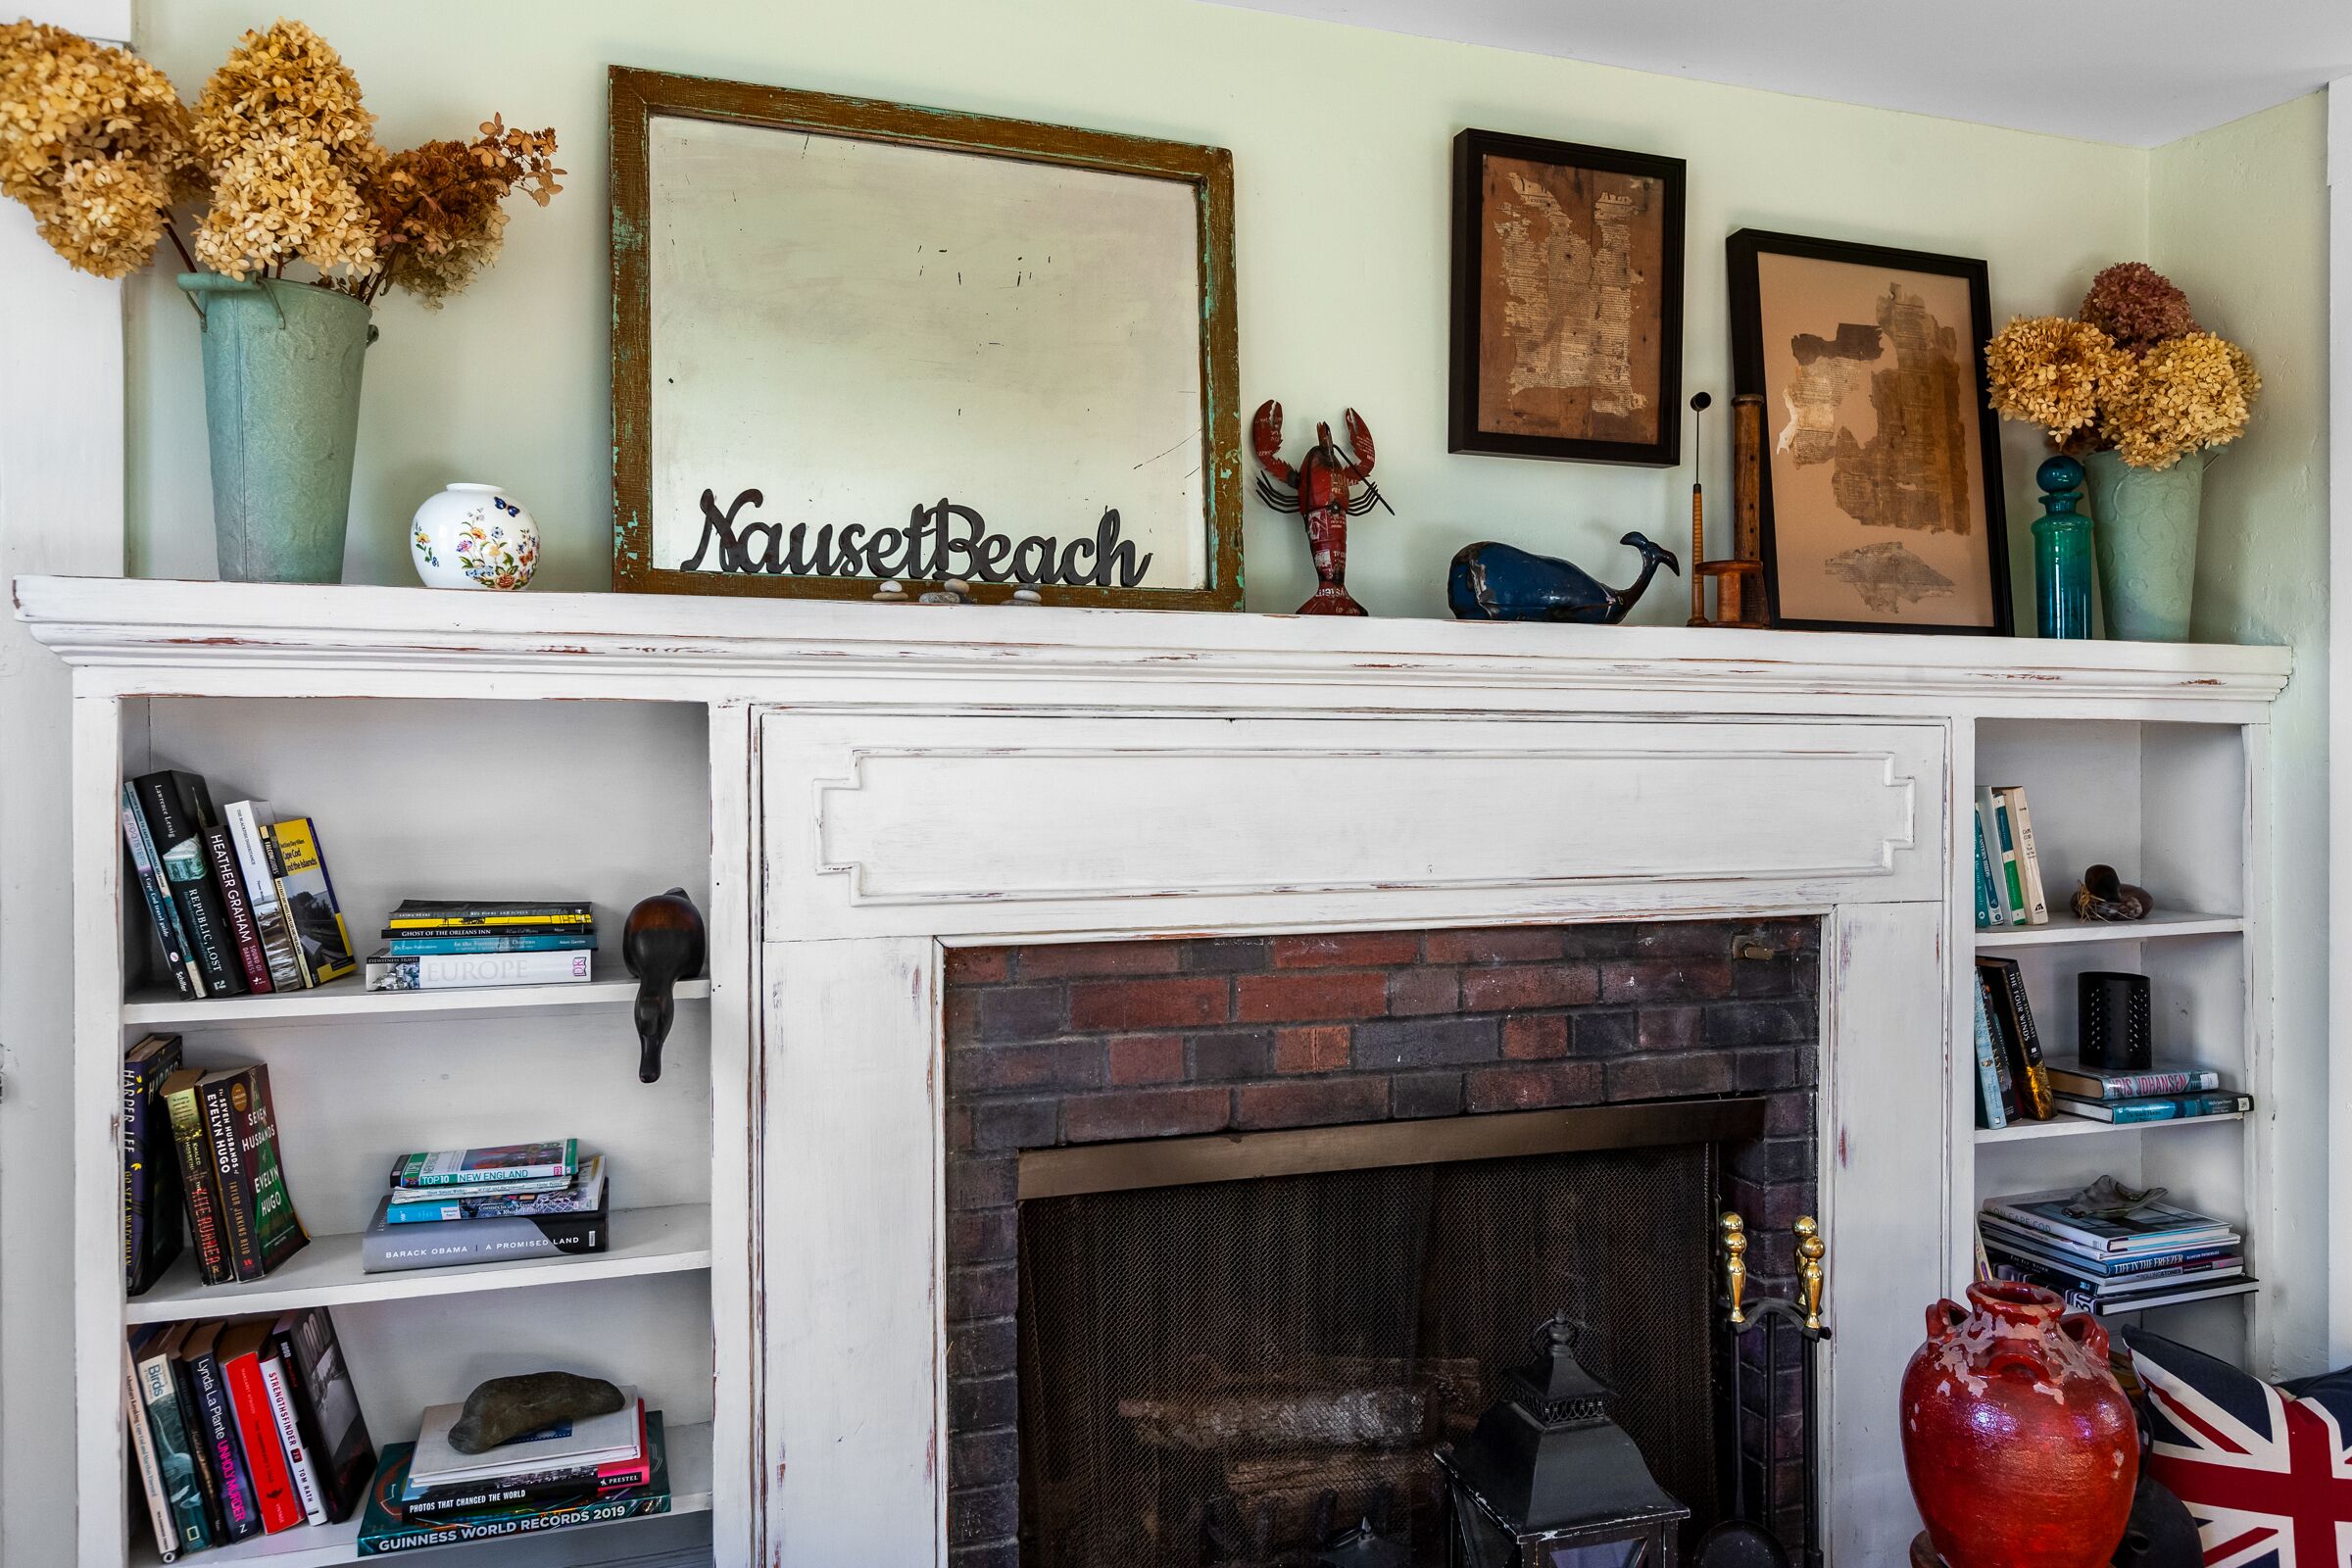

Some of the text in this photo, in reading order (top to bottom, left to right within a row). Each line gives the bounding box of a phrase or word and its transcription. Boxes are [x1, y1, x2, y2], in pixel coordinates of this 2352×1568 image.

[155, 784, 175, 838] Lawrence Lessig
[128, 821, 147, 865] FOOTSTEPS
[292, 848, 301, 858] Cod
[1977, 833, 1986, 859] EASTERN
[300, 857, 317, 868] Islands
[143, 877, 152, 891] Cape
[211, 834, 251, 942] HEATHER GRAHAM
[149, 892, 158, 904] Cod
[153, 904, 164, 921] travel
[158, 921, 169, 937] guide
[189, 889, 211, 944] REPUBLIC,
[207, 945, 221, 970] LOST
[242, 946, 256, 974] DARKNESS
[249, 944, 260, 963] SOUND
[174, 970, 188, 992] Schiffer
[428, 959, 528, 982] EUROPE
[2008, 973, 2029, 1041] THE FOUR WINDS
[2016, 972, 2035, 1037] KRISTIN HANNAH
[2111, 1078, 2133, 1098] IRIS
[2136, 1073, 2188, 1096] JOHANSEN
[219, 1097, 230, 1123] SEVEN
[248, 1106, 267, 1126] SEVEN
[206, 1093, 230, 1173] EVELYN HUGO
[224, 1125, 239, 1167] HUSBANDS
[242, 1124, 275, 1152] HUSBANDS
[192, 1142, 201, 1166] KHALED
[124, 1170, 131, 1183] GO
[254, 1164, 280, 1194] EVELYN
[459, 1172, 481, 1183] NEW
[483, 1169, 529, 1180] ENGLAND
[192, 1189, 211, 1215] KITE
[261, 1191, 282, 1217] HUGO
[228, 1180, 250, 1254] TAYLOR JENKINS REID
[2007, 1212, 2030, 1224] CAPE
[2031, 1220, 2051, 1232] COD
[198, 1217, 222, 1264] RUNNER
[386, 1246, 468, 1258] BARACK OBAMA
[496, 1239, 549, 1250] PROMISED
[553, 1236, 579, 1245] LAND
[2115, 1254, 2183, 1274] LIFE IN THE FREEZER
[148, 1363, 166, 1396] Birds
[240, 1367, 255, 1414] MARGARET ATWOOD
[269, 1372, 295, 1445] STRENGTHSFINDER
[197, 1358, 246, 1521] Lynda La Plante UNHOLY MURDER
[298, 1468, 312, 1502] TOM RATH
[609, 1475, 639, 1484] PRESTEL
[274, 1502, 284, 1523] VINTAGE
[409, 1490, 526, 1514] PHOTOS THAT CHANGED THE WORLD
[379, 1506, 626, 1552] GUINNESS WORLD RECORDS 2019
